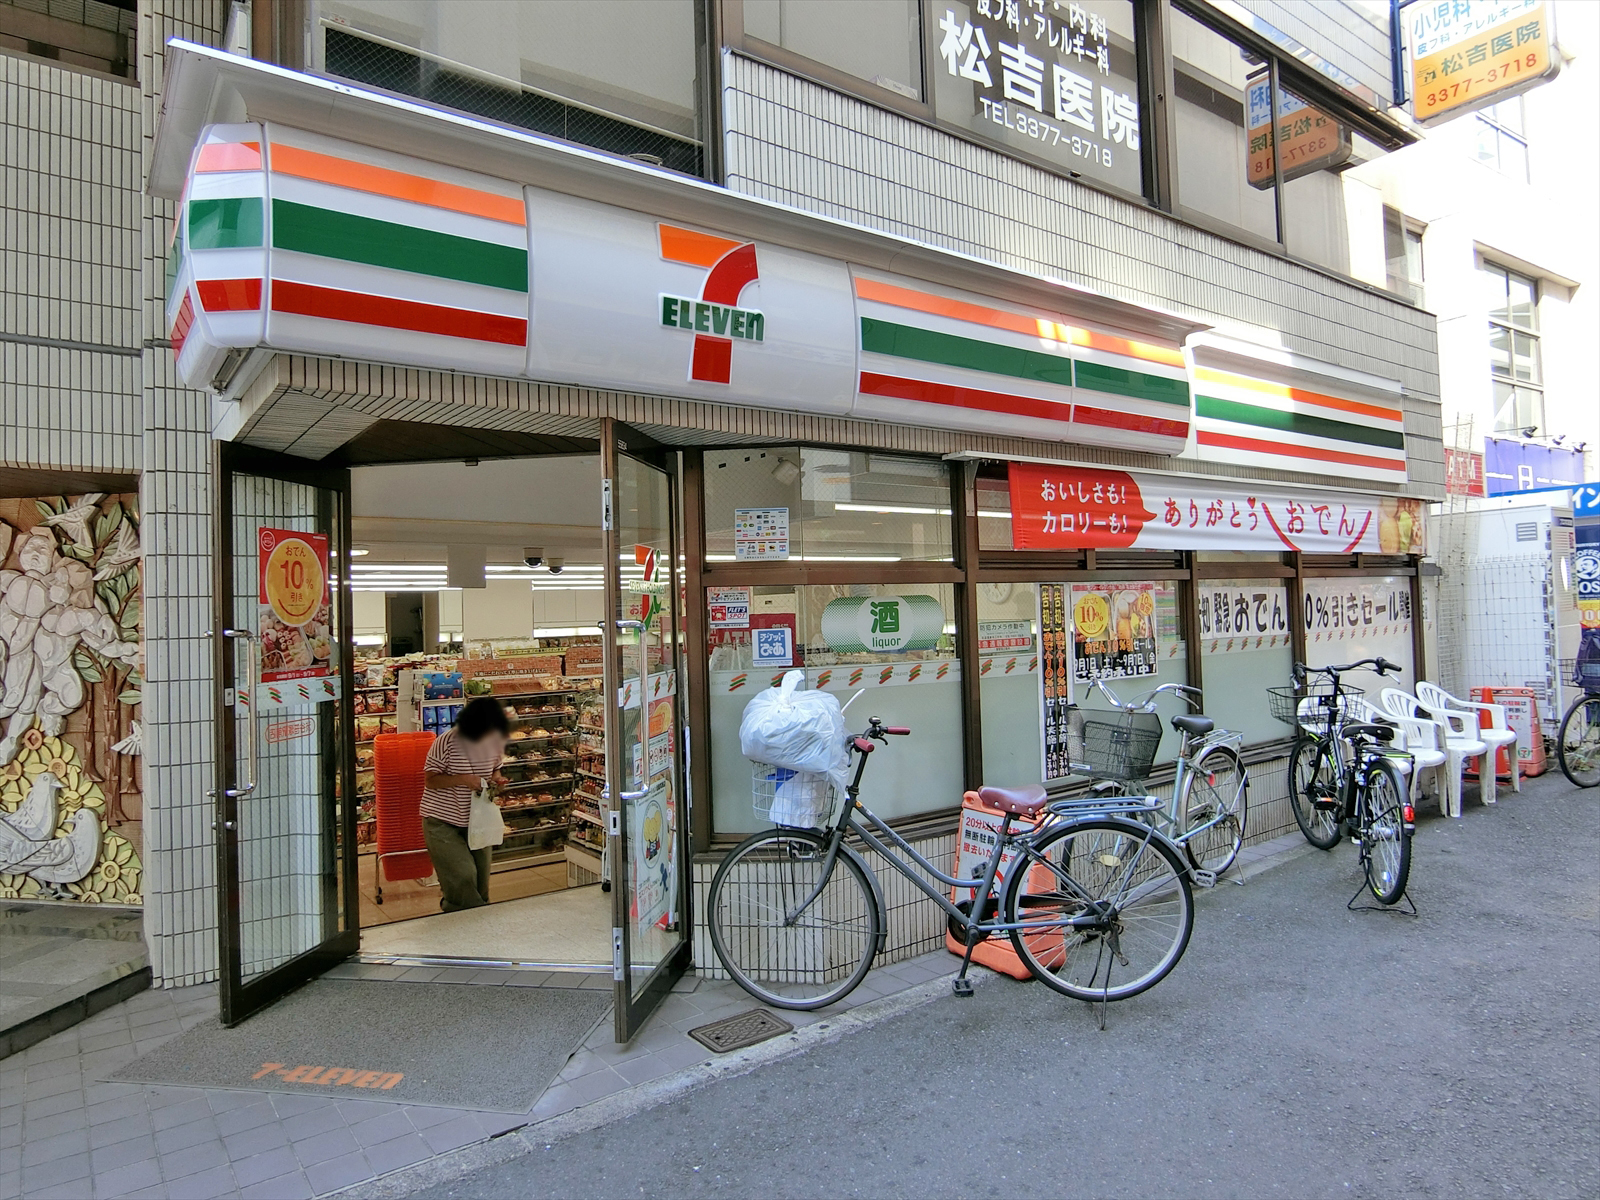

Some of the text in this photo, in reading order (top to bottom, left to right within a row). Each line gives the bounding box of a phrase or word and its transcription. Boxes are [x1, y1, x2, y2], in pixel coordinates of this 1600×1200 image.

[1441, 20, 1541, 76] 松吉医院
[939, 9, 1140, 151] 松吉医院
[1426, 53, 1537, 106] 3377-3718
[1164, 497, 1356, 537] ありがとう おでん
[285, 545, 307, 558] おでん
[870, 601, 900, 633] 酒
[760, 632, 785, 642] チケット
[760, 642, 785, 657] ぴあ
[871, 636, 902, 648] liquor
